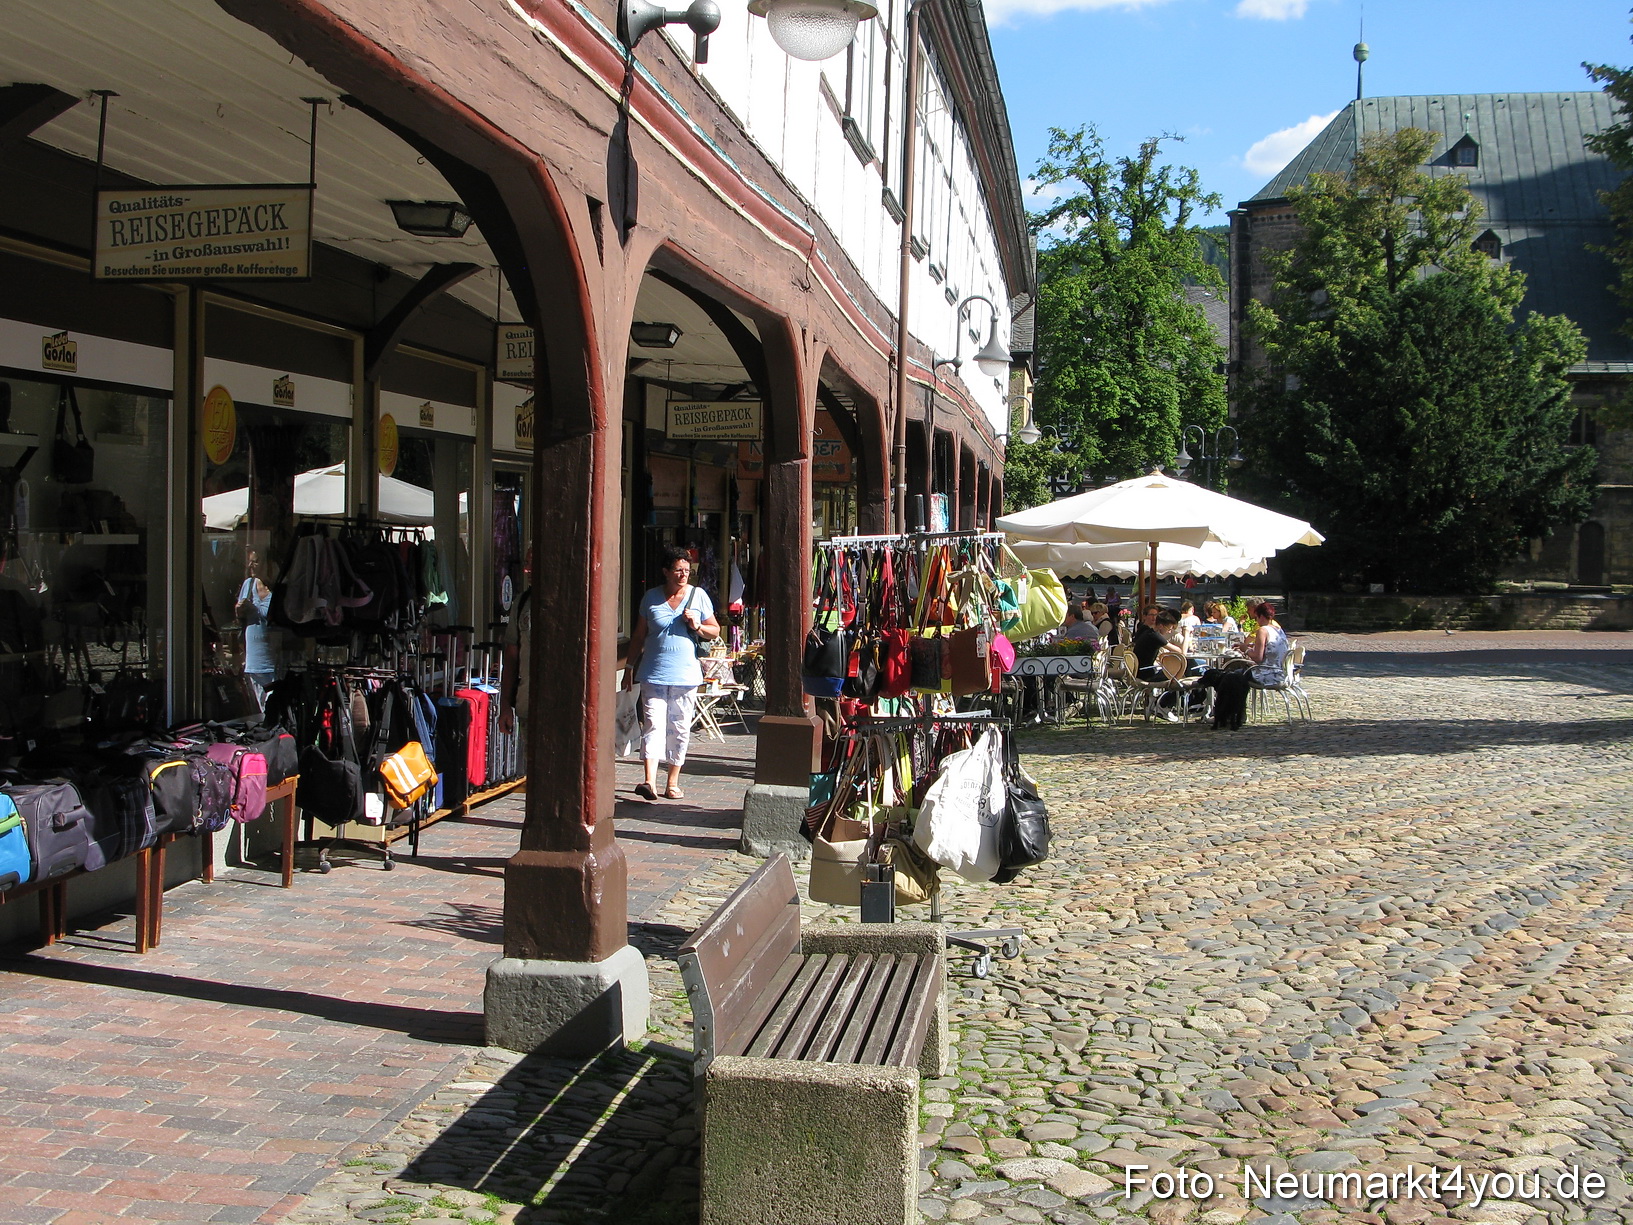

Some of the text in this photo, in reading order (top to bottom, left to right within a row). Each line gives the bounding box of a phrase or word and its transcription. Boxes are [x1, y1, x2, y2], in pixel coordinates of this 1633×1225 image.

[110, 203, 288, 247] REISEGEPÄCK
[172, 237, 290, 260] Großauswahl!
[104, 263, 298, 277] Besuchen Sie unsere große Kofferetage
[44, 343, 76, 363] Goslar
[675, 407, 752, 425] REISEGEPÄCK
